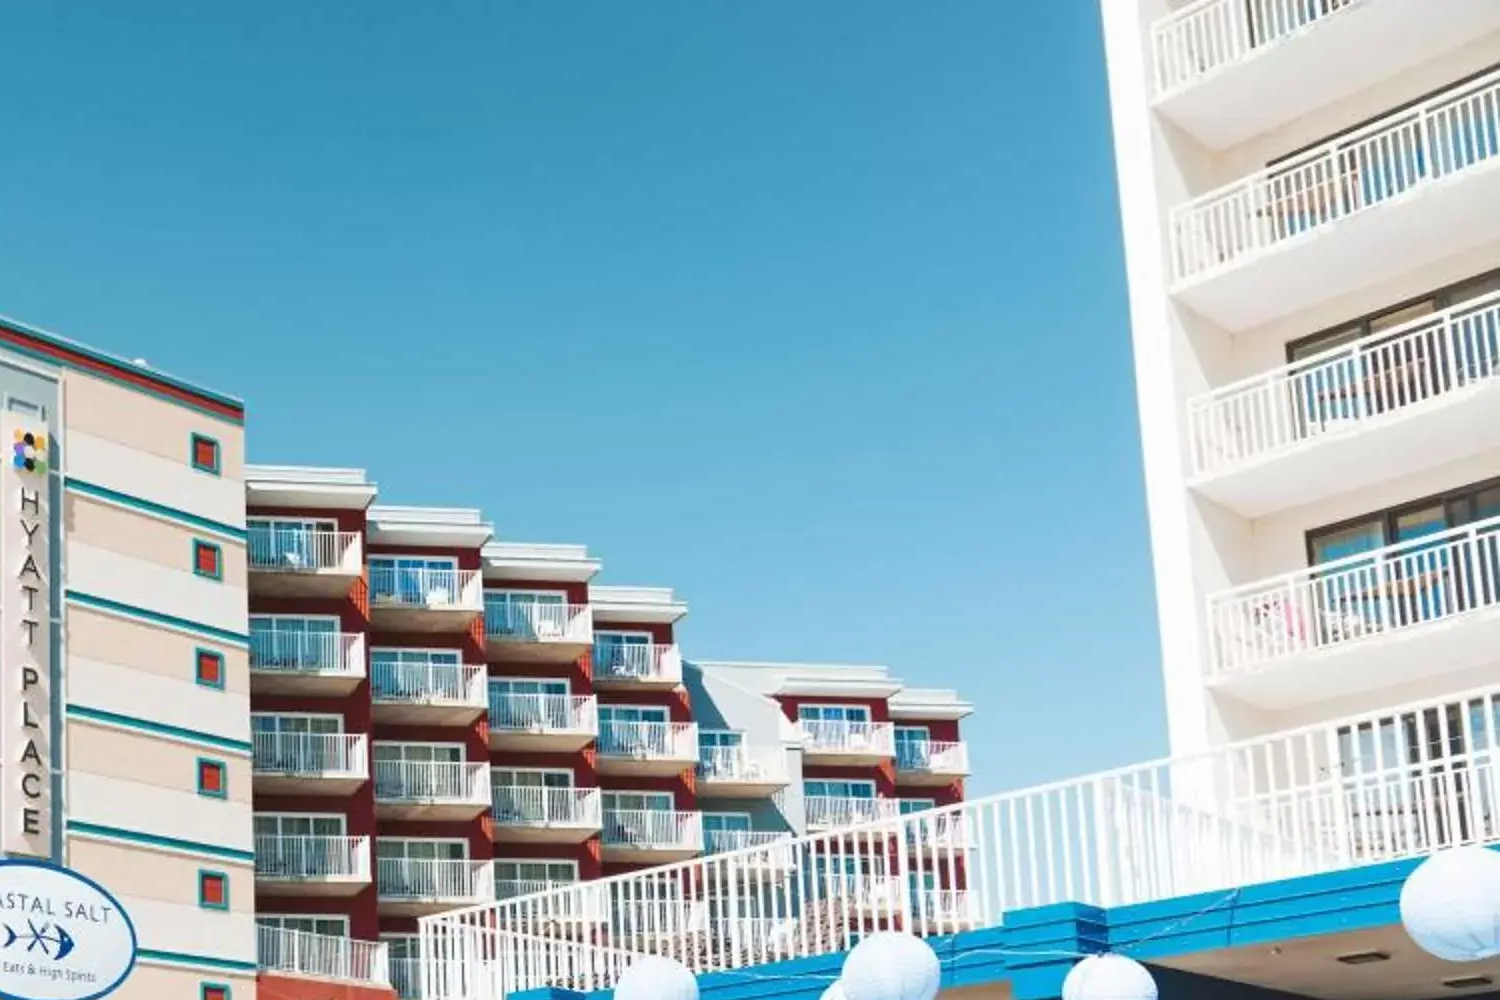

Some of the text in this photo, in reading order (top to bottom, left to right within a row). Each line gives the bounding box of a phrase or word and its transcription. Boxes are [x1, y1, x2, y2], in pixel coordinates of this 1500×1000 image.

[20, 486, 41, 836] HYATT PLACE
[64, 900, 112, 923] SALT
[3, 961, 25, 975] Eats
[27, 963, 36, 975] &
[40, 966, 63, 981] High
[66, 968, 97, 984] Spirits
